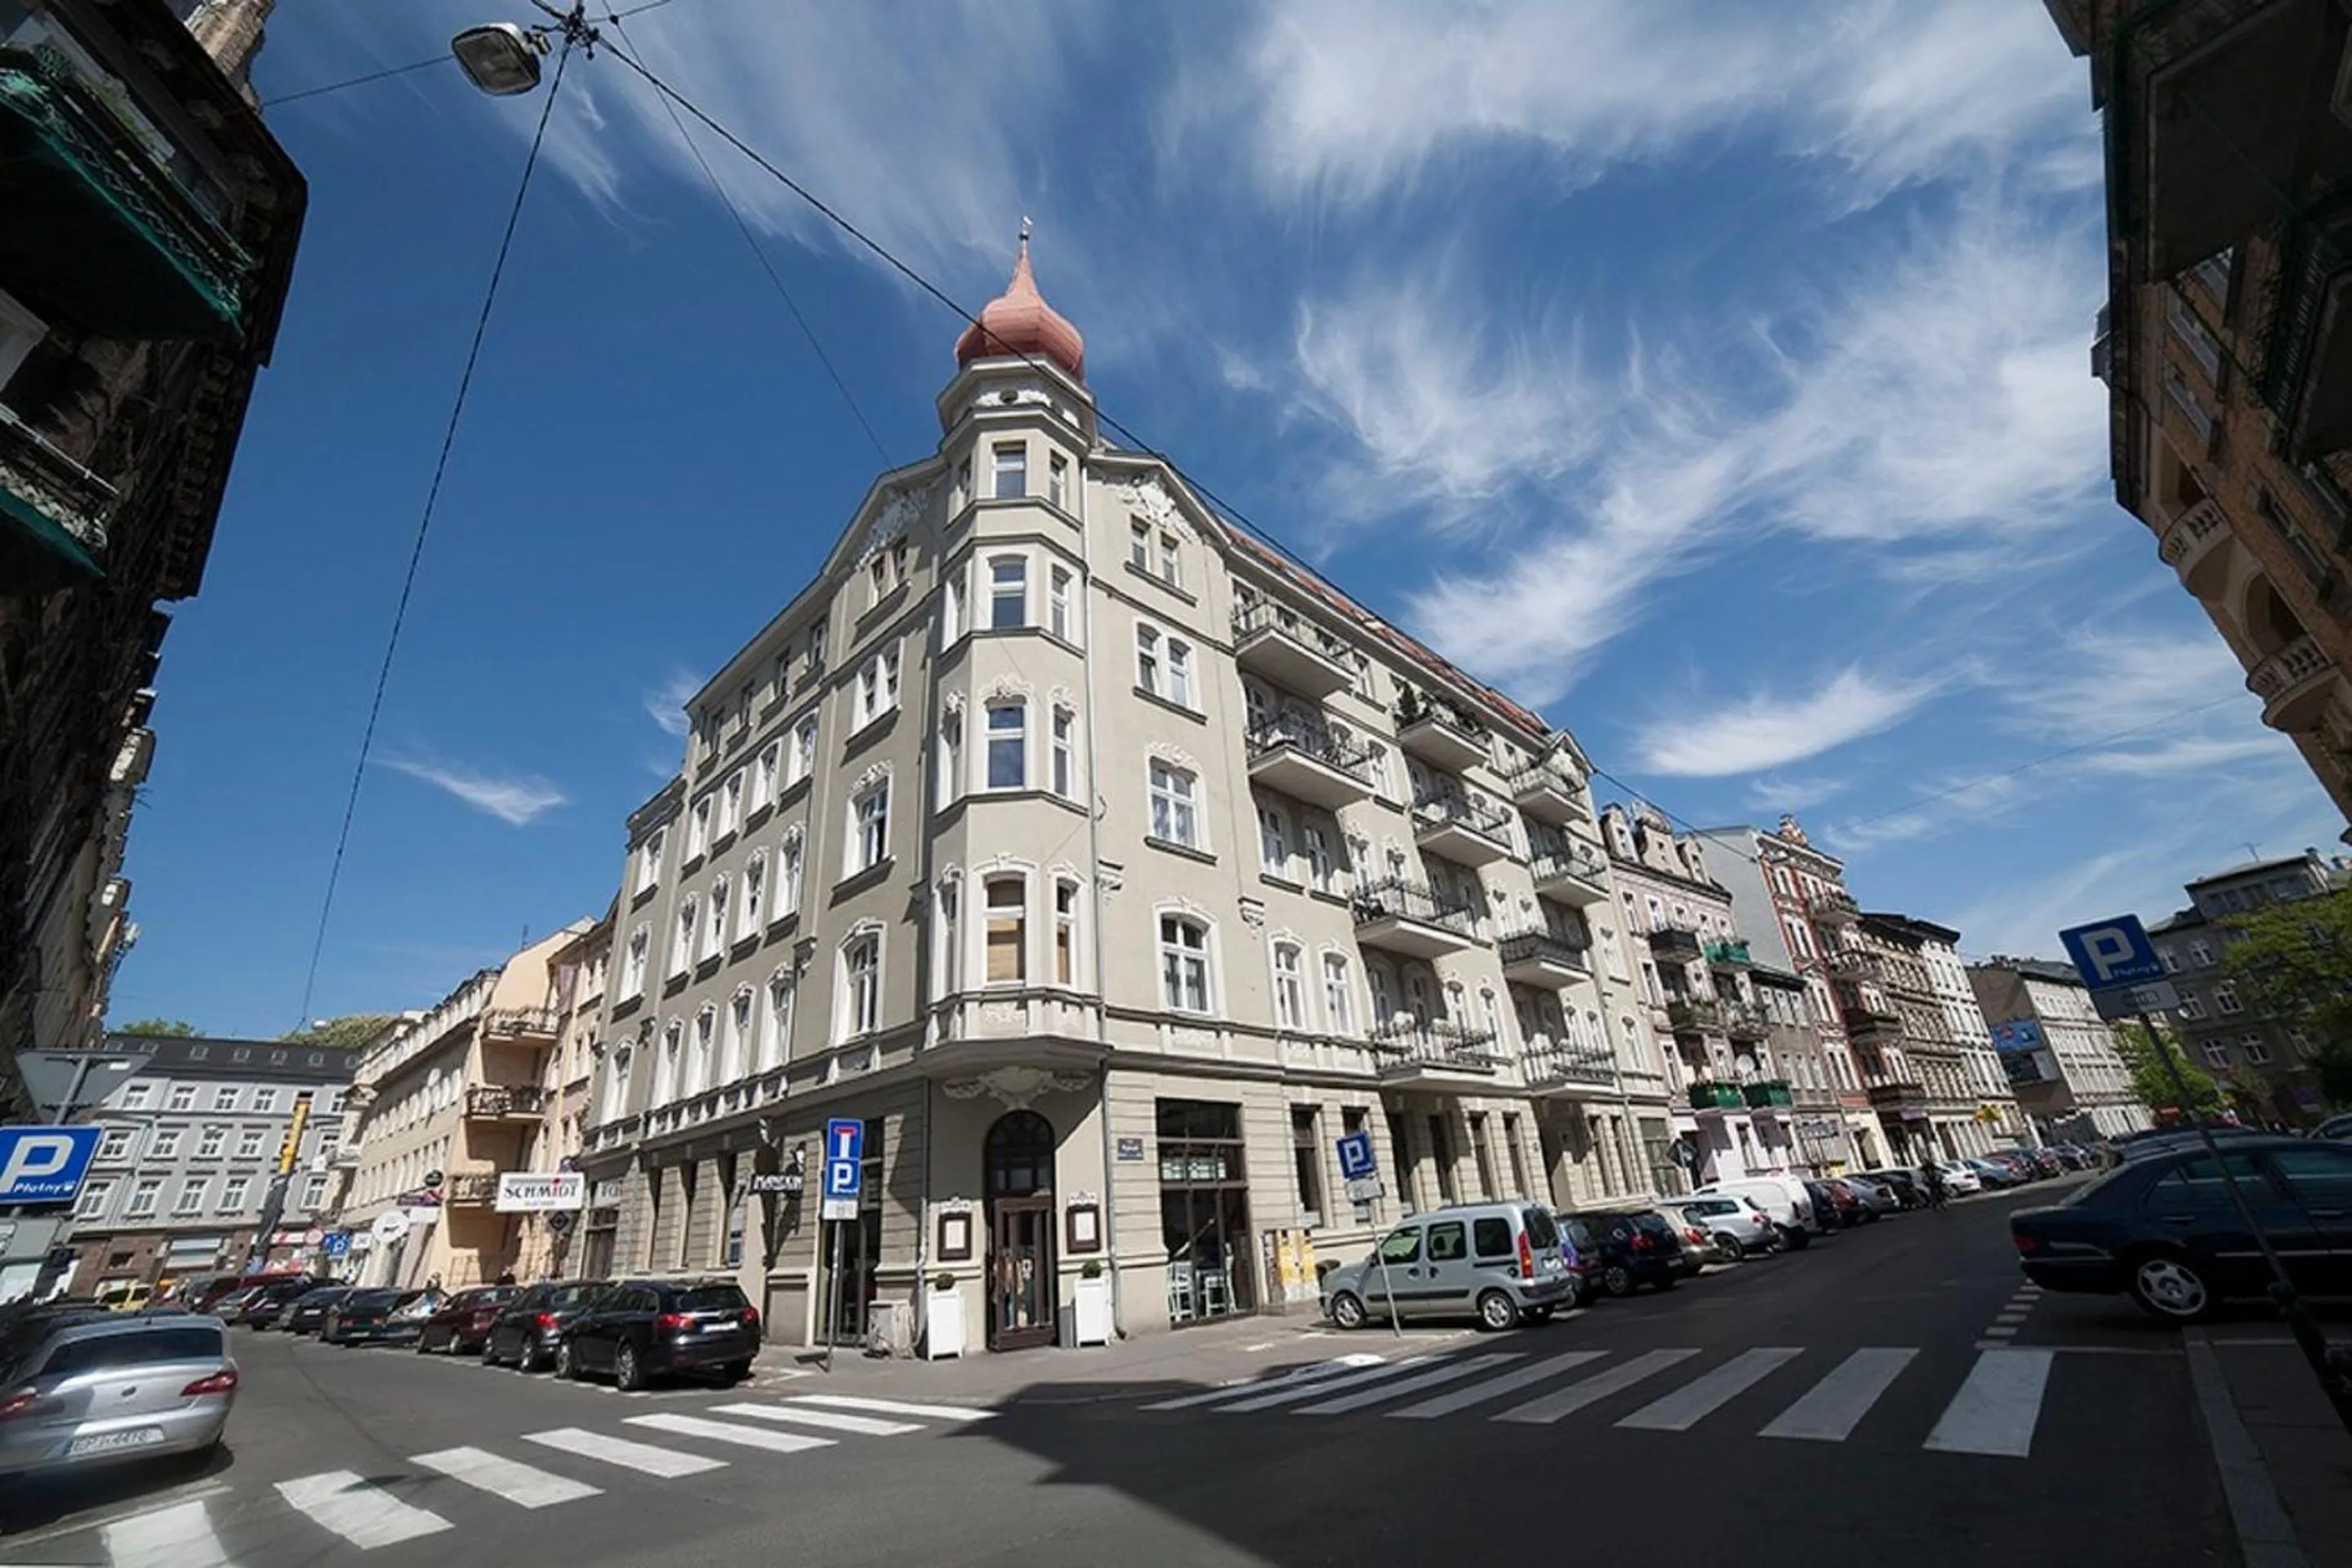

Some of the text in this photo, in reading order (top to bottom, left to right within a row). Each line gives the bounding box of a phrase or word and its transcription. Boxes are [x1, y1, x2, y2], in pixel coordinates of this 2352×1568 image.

[2080, 928, 2136, 981] P
[0, 1136, 74, 1193] P
[832, 1162, 853, 1193] P
[1343, 1139, 1364, 1173] P
